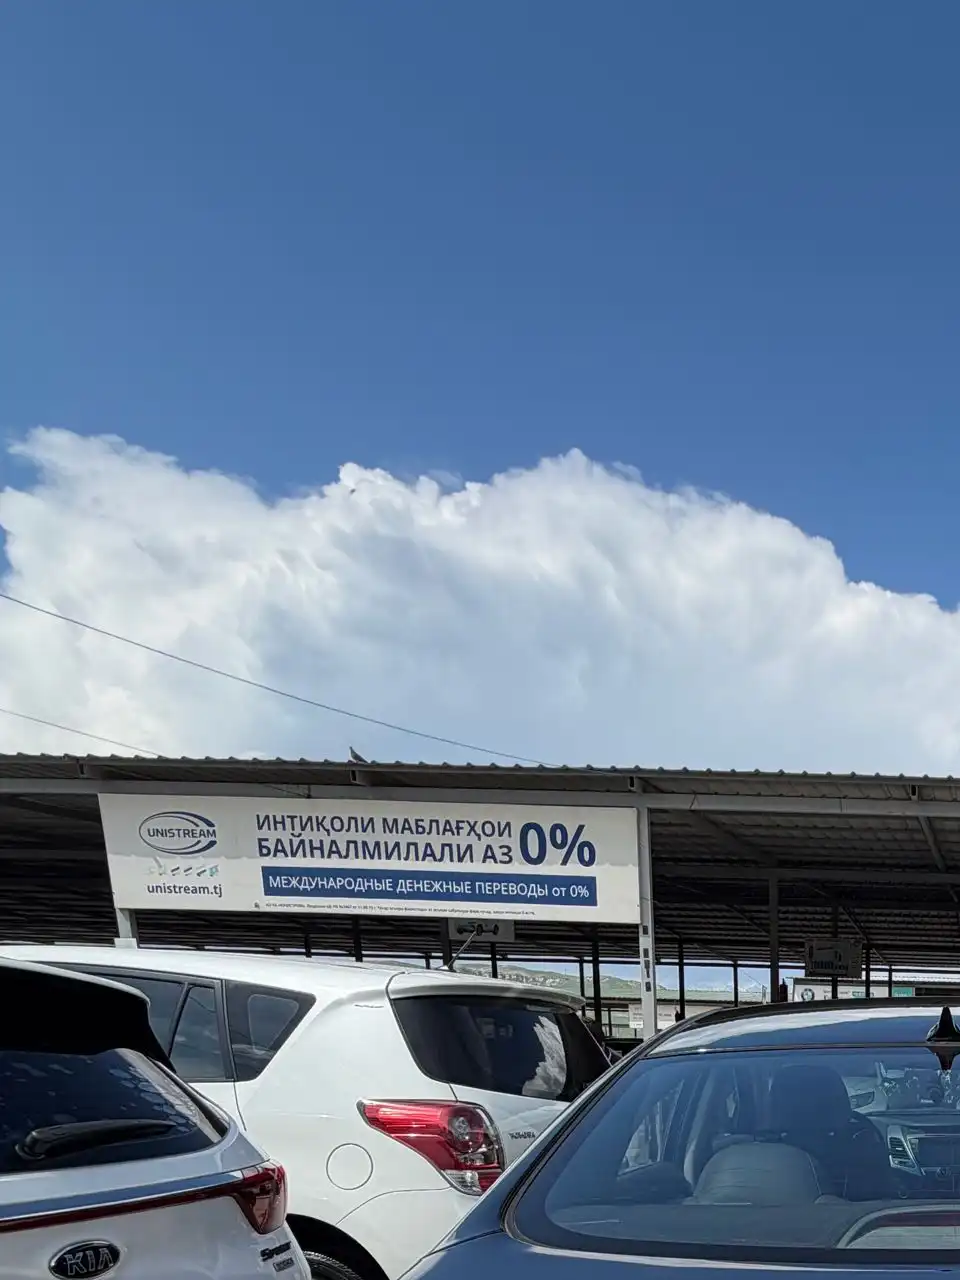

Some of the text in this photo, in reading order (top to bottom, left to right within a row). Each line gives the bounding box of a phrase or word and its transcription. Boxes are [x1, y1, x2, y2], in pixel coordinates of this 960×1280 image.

[147, 827, 218, 839] UNISTREAM
[255, 814, 513, 842] ИНТИҚОЛИ МАБЛАҒҲОИ
[256, 821, 597, 868] БАЙНАЛМИЛАЛИ АЗ 0%
[146, 882, 223, 898] unistream.tj
[268, 874, 590, 899] МЕЖДУНАРОДНЫЕ ДЕНЕЖНЫЕ ПЕРЕВОДЫ от 0%
[63, 1247, 114, 1276] KIA
